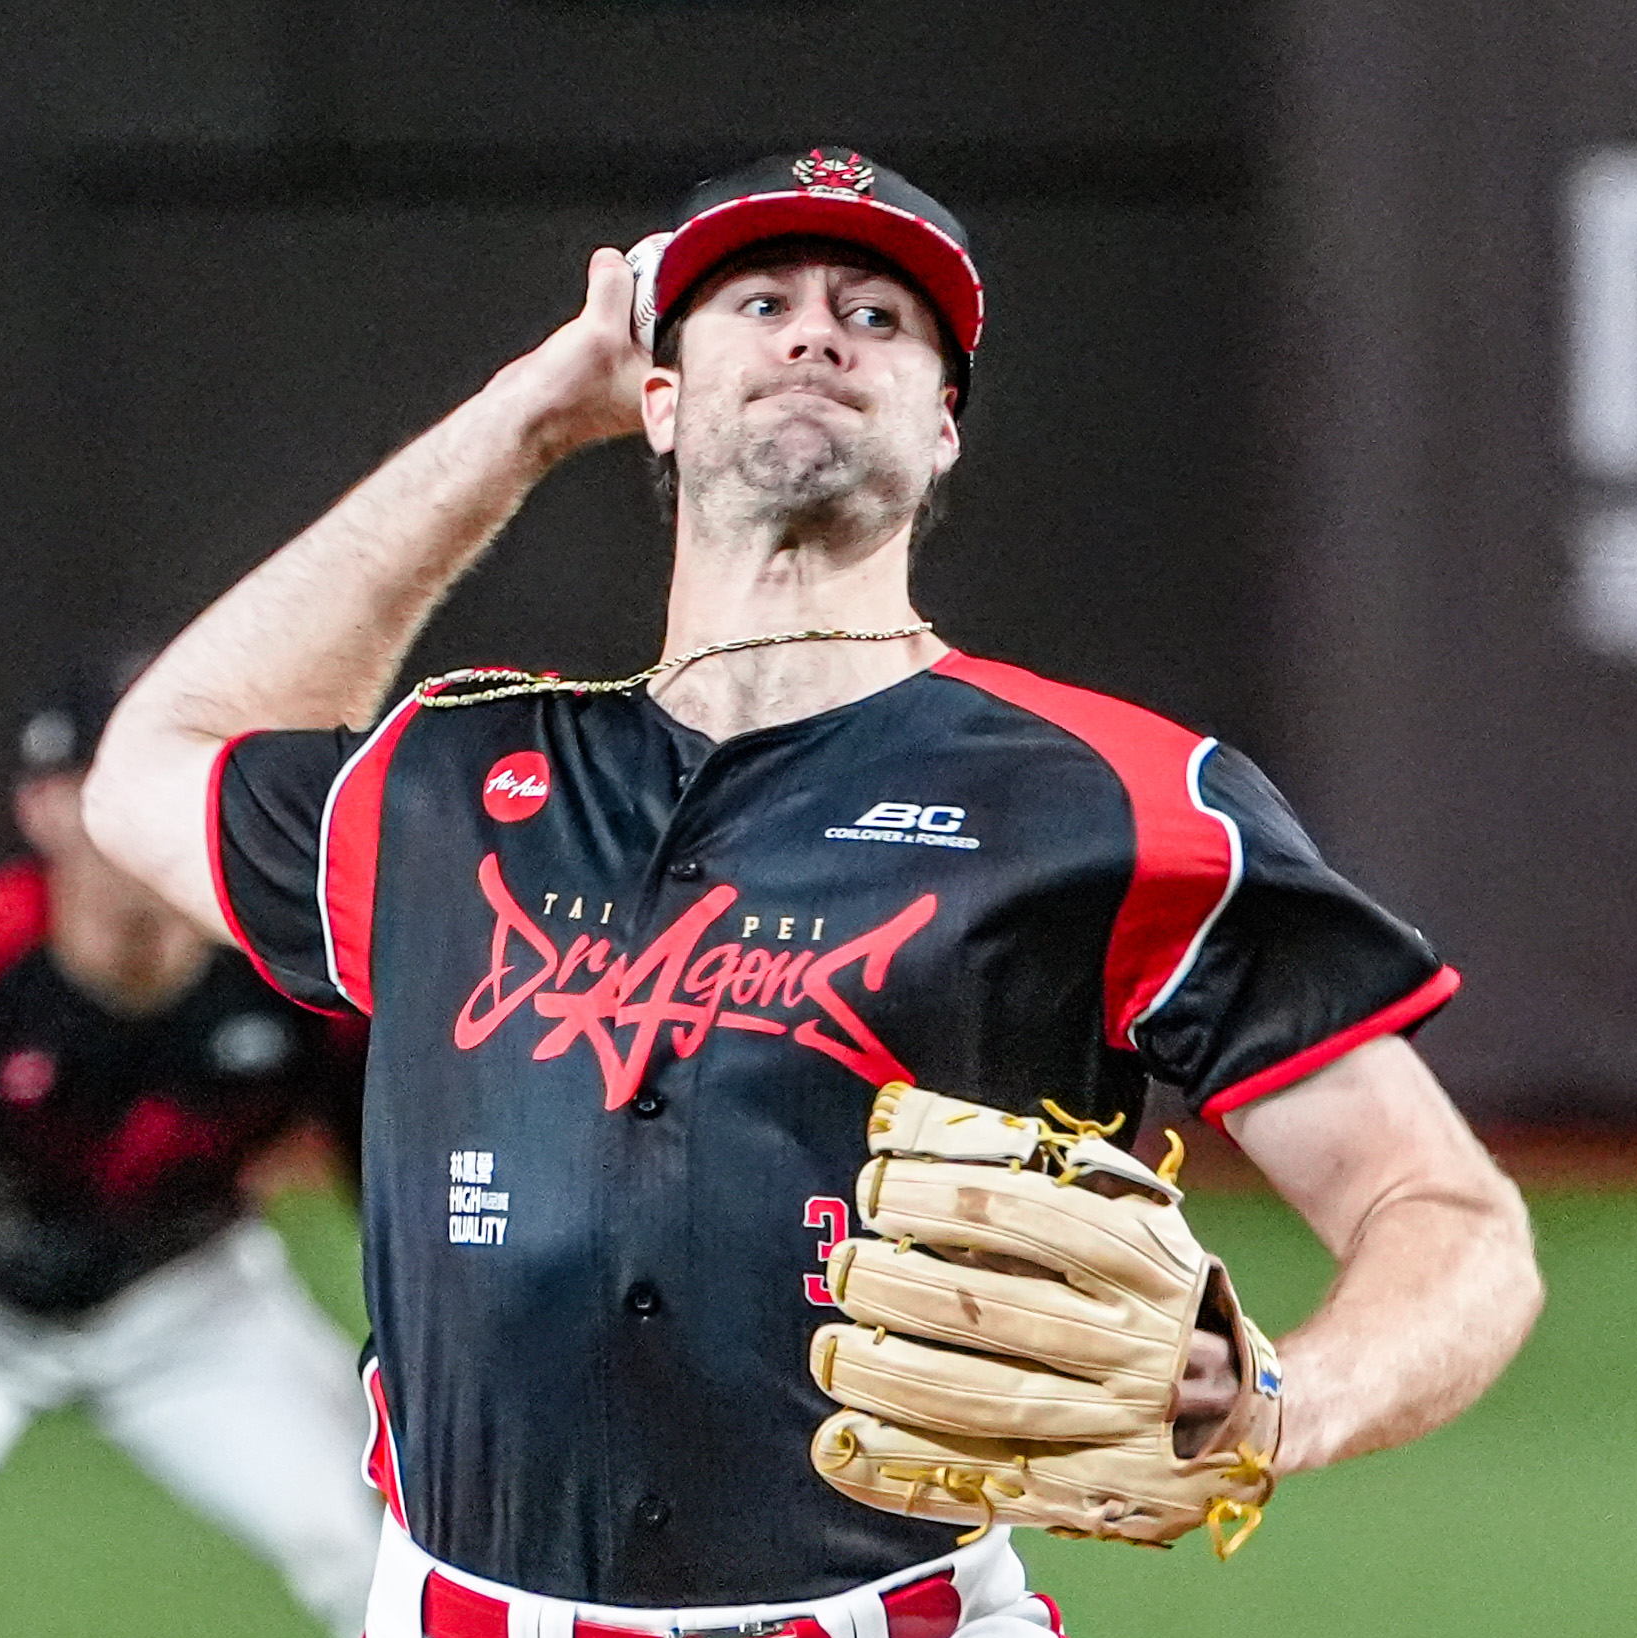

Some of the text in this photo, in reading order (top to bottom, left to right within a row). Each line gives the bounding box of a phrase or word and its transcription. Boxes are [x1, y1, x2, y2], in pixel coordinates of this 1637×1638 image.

[854, 802, 966, 833] BC
[449, 1186, 482, 1213] HIGH
[448, 1215, 508, 1246] QUALITY
